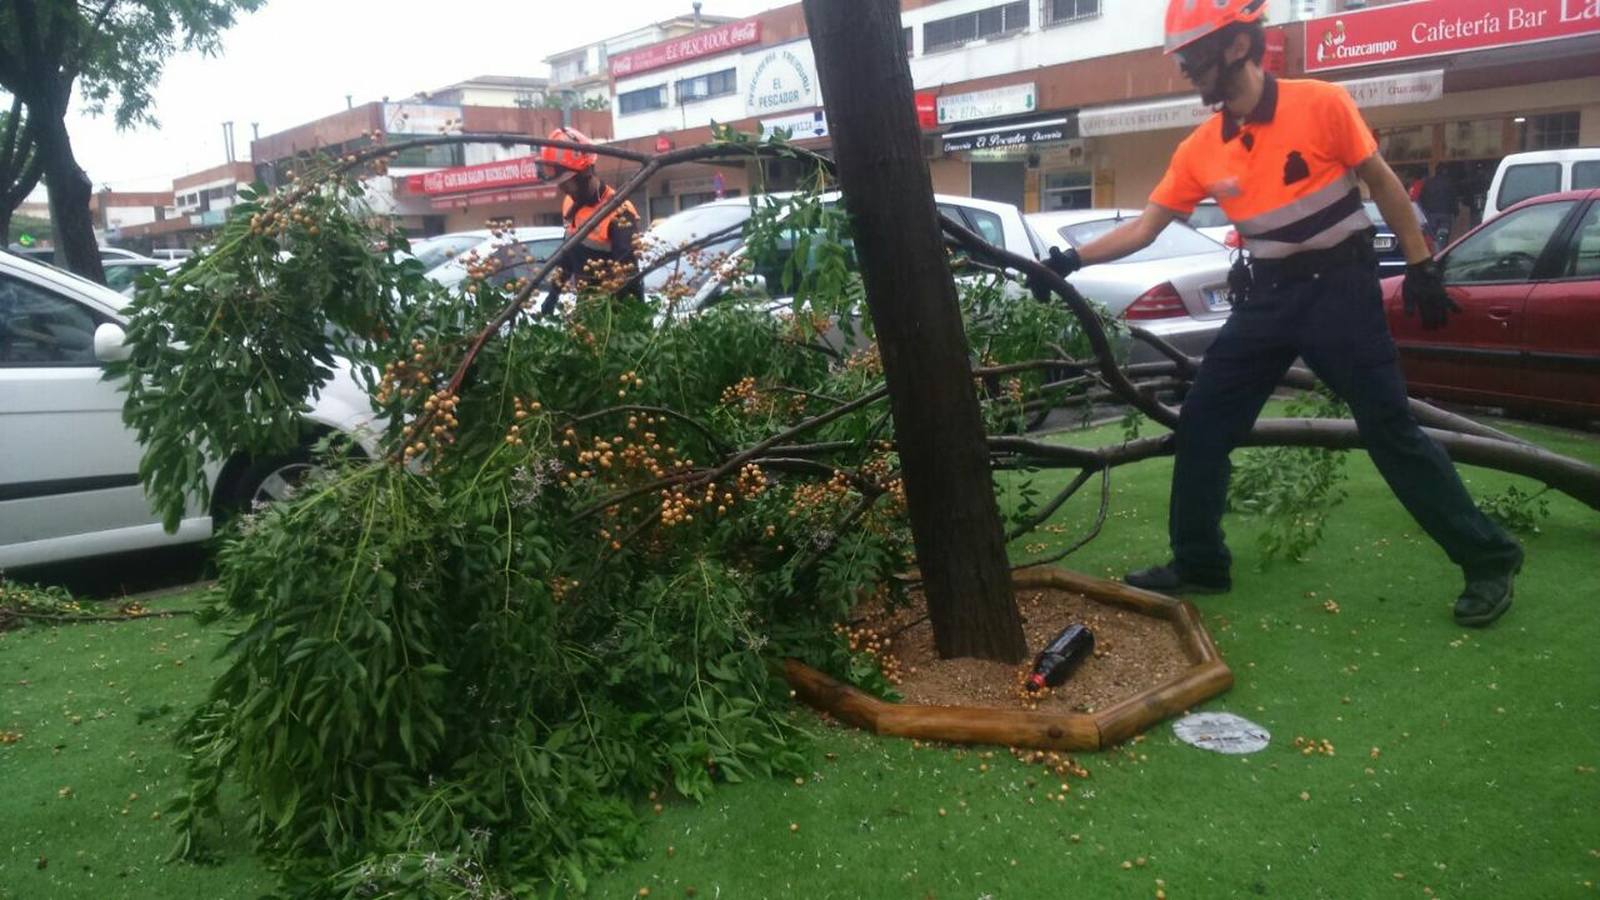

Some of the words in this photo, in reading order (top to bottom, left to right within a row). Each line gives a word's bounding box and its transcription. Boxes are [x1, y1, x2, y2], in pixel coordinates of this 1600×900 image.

[1411, 12, 1500, 44] Cafetería
[1508, 8, 1547, 30] Bar
[666, 45, 679, 60] EL
[679, 28, 731, 57] PESCADOR
[1336, 40, 1397, 59] Cruzcampo
[772, 78, 783, 90] EL
[759, 88, 800, 108] PESCADOR
